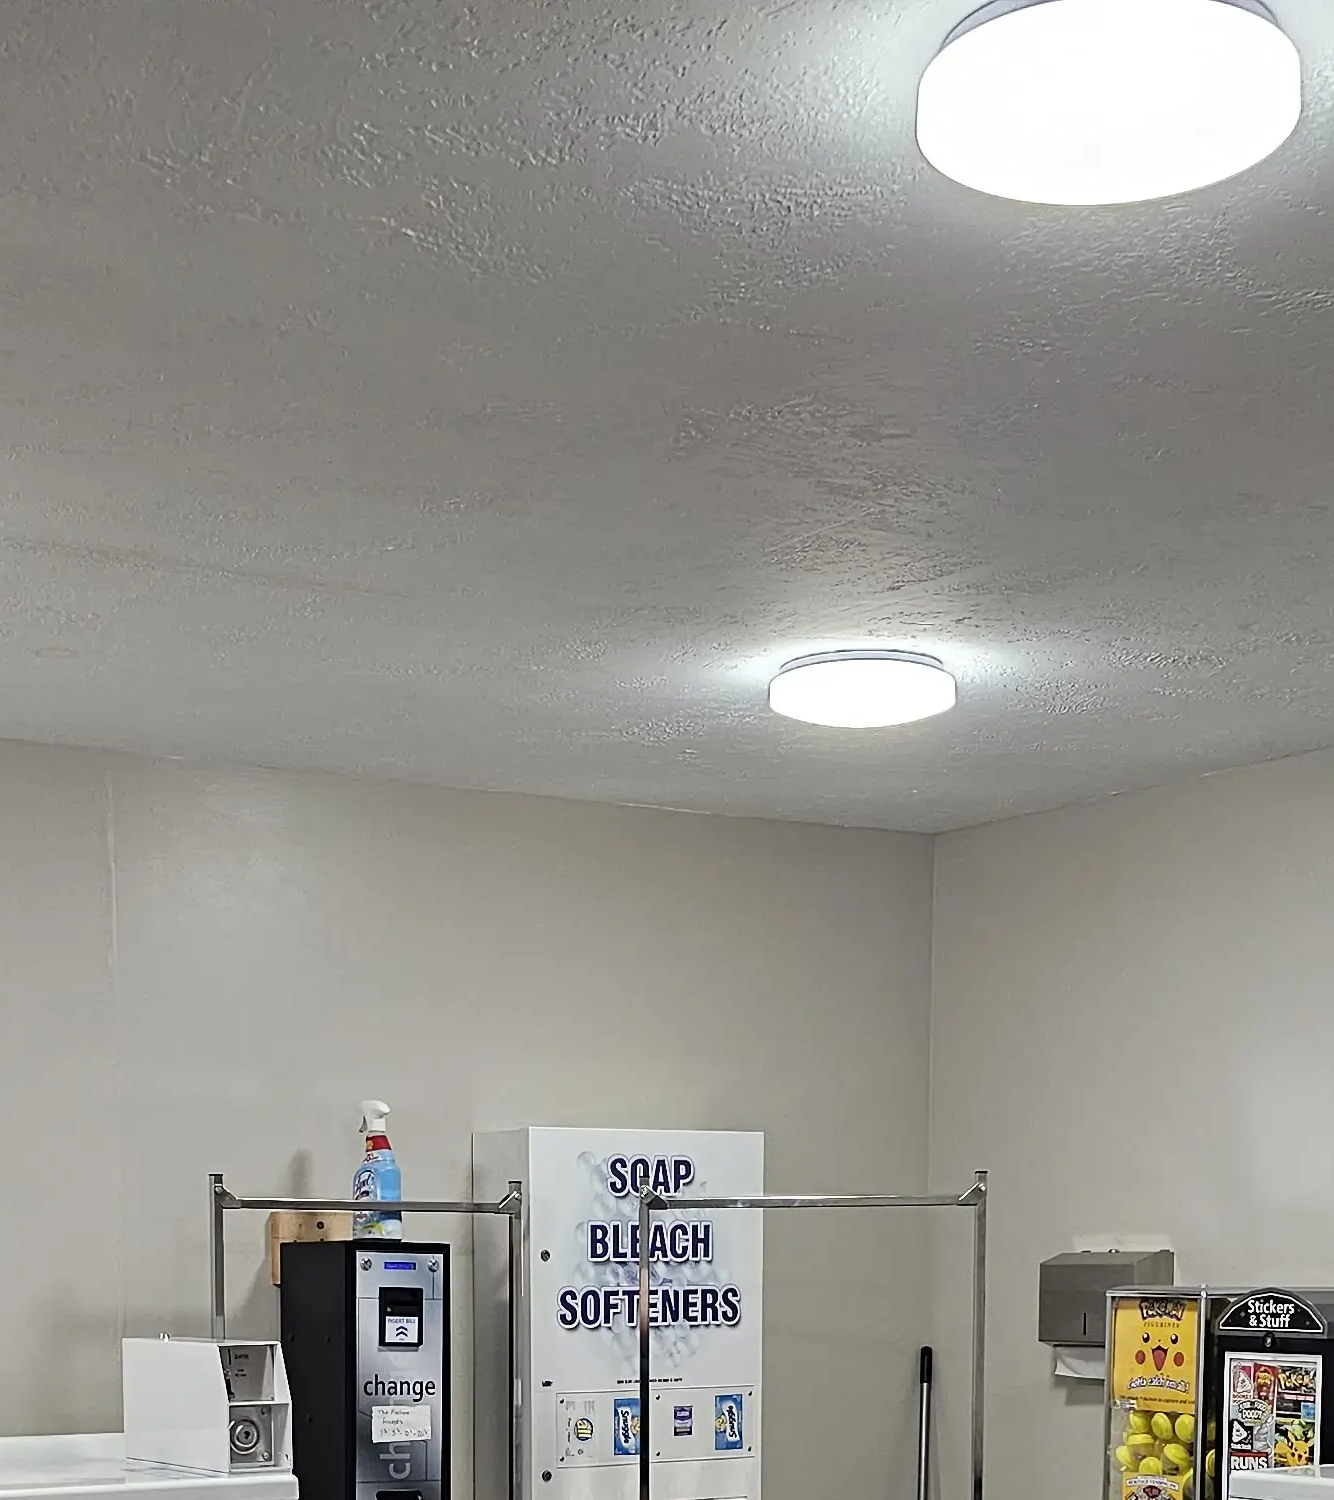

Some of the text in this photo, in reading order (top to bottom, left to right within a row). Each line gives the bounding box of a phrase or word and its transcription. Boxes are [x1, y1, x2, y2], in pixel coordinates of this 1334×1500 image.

[609, 1157, 693, 1194] SOAP
[589, 1223, 711, 1259] BLEACH
[559, 1287, 739, 1326] SOFTENERS
[1247, 1299, 1295, 1314] Stickers
[1249, 1313, 1291, 1328] & Stuff
[364, 1374, 436, 1402] change
[620, 1409, 632, 1444] Snuggle
